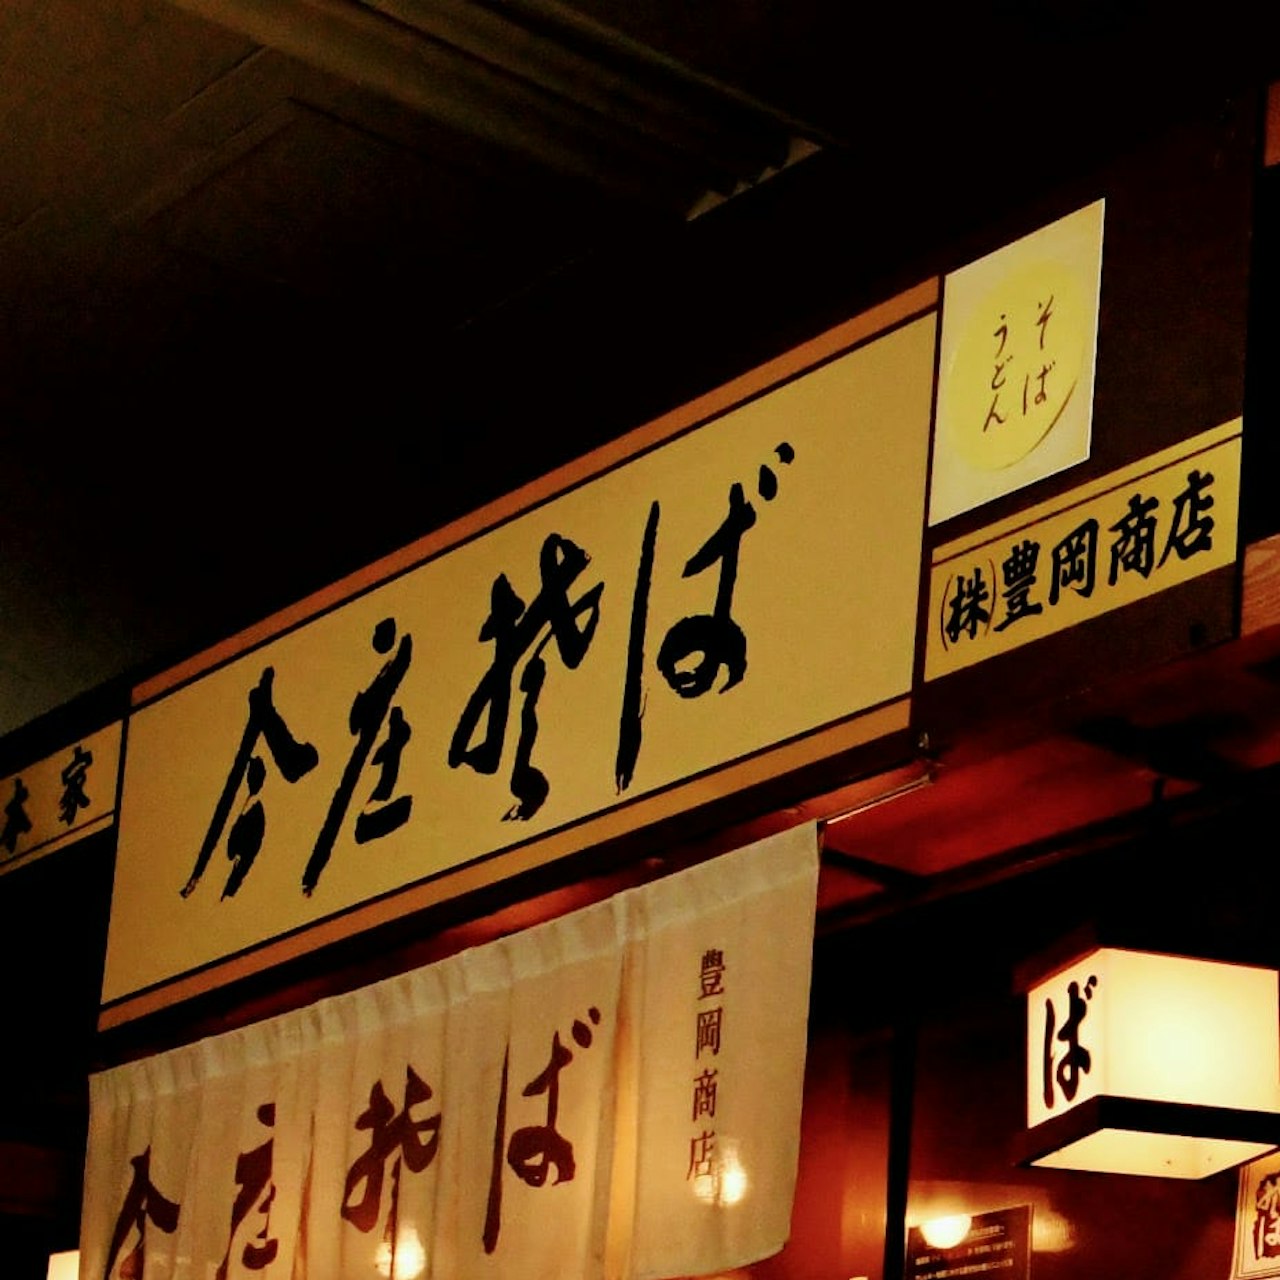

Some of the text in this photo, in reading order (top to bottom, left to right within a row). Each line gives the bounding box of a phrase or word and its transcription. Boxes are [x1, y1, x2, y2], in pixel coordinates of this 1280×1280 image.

[982, 313, 1010, 434] うどん
[1022, 294, 1056, 416] そば
[684, 948, 728, 1183] 豊岡商店
[1042, 974, 1099, 1110] ば
